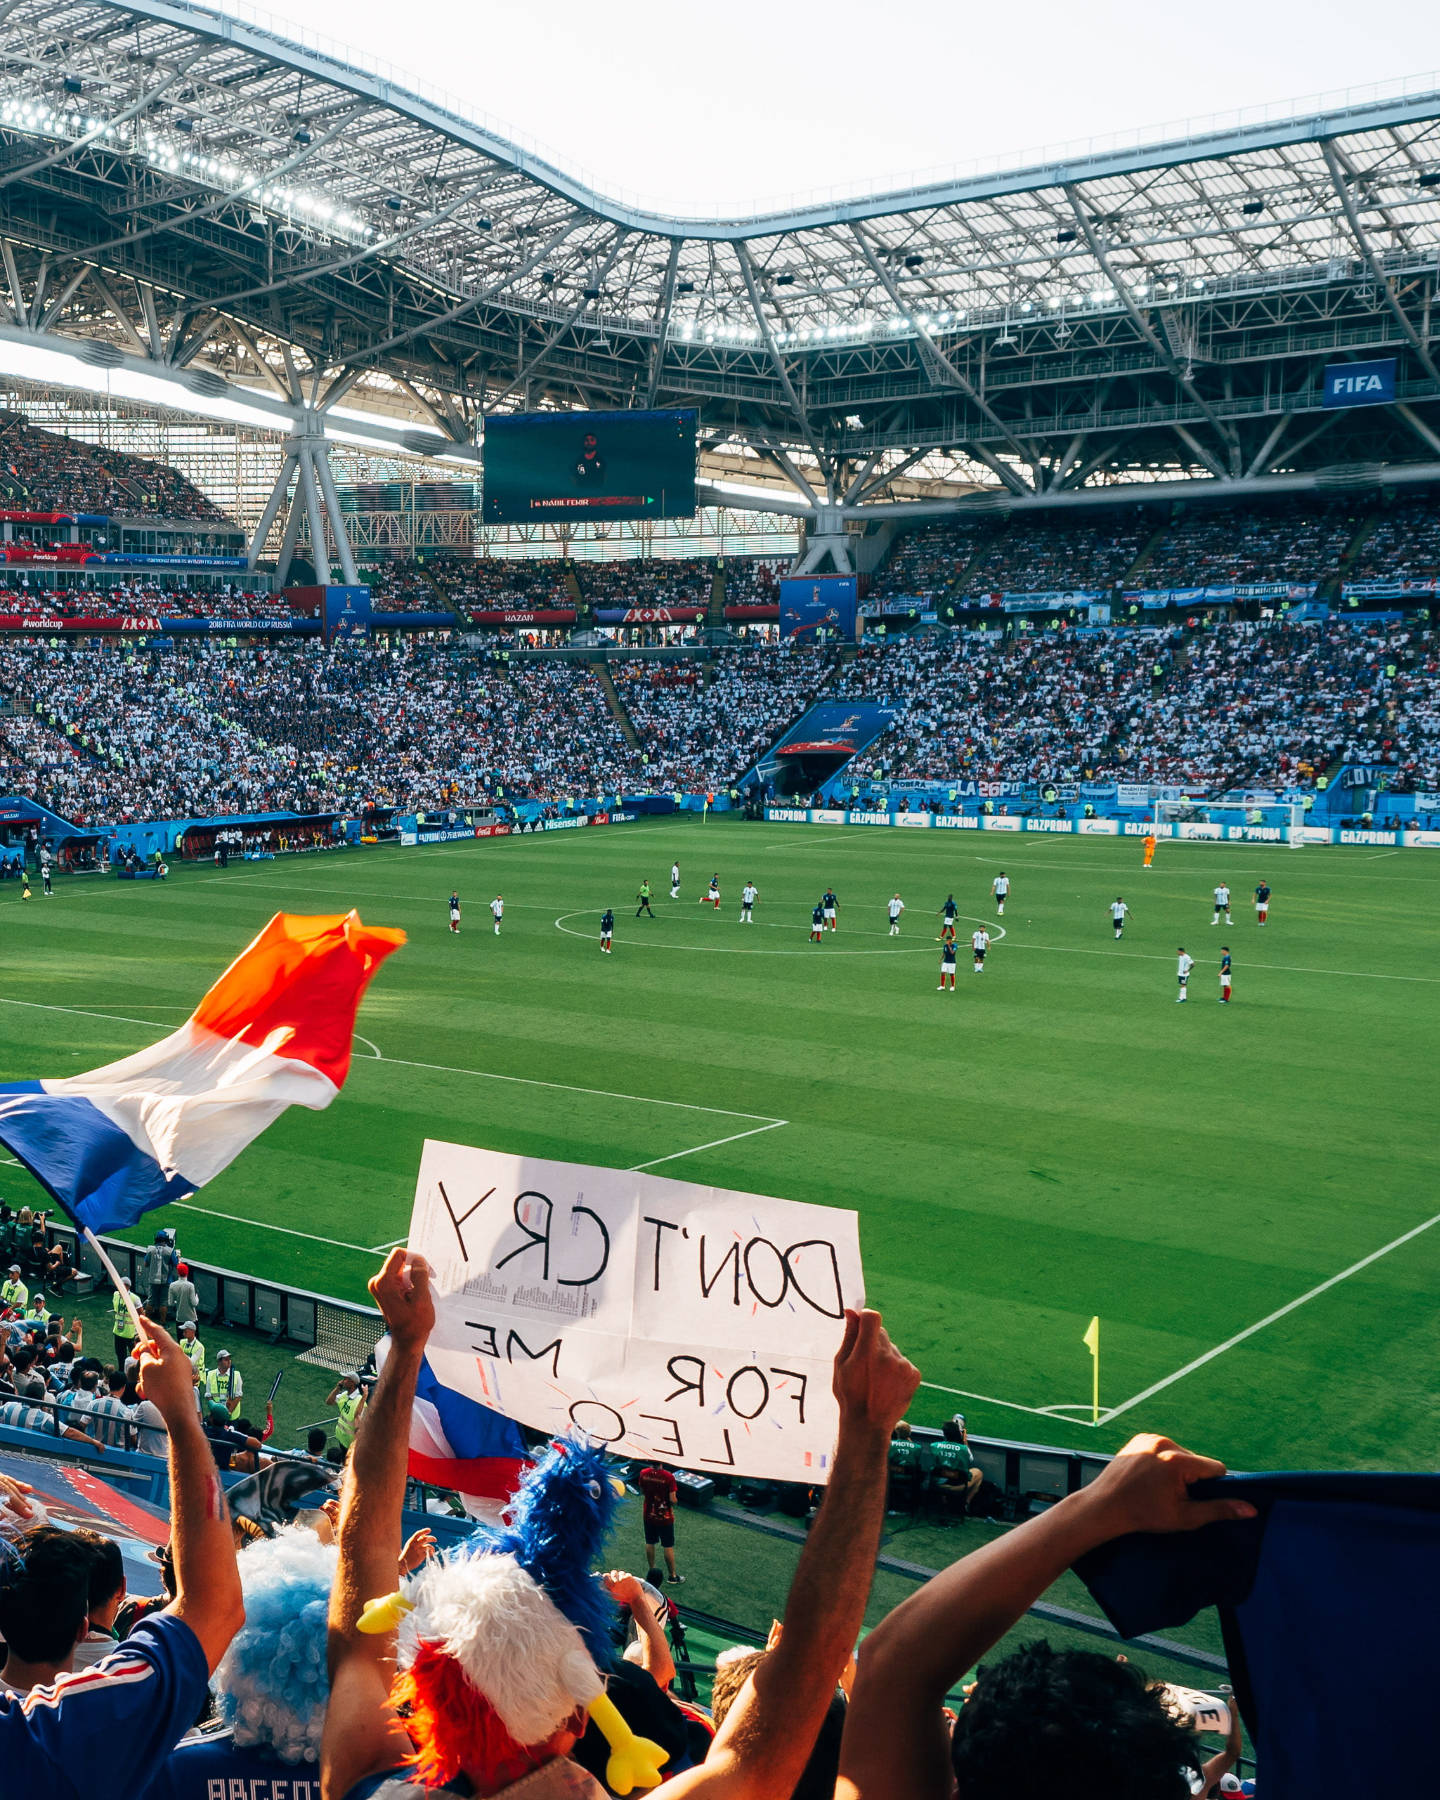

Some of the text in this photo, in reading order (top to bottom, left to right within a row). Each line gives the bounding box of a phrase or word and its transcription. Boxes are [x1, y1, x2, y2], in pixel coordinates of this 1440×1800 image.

[1333, 375, 1383, 394] FIFA
[542, 499, 565, 507] NABIL
[23, 618, 63, 630] #worldcup
[504, 614, 534, 622] KAZAN
[208, 620, 292, 629] 2018 FIFA WORLD CUP RUSSIA
[769, 810, 807, 822] GAZPROM
[850, 813, 890, 825] GAZPROM
[936, 816, 978, 828] GAZPROM
[544, 819, 577, 831] Hisense
[1027, 819, 1072, 832] GAZPROM
[1229, 827, 1281, 841] GAZPROM
[1340, 831, 1396, 845] GAZPROM
[891, 1440, 916, 1449] PHOTO
[937, 1443, 961, 1451] PHOTO
